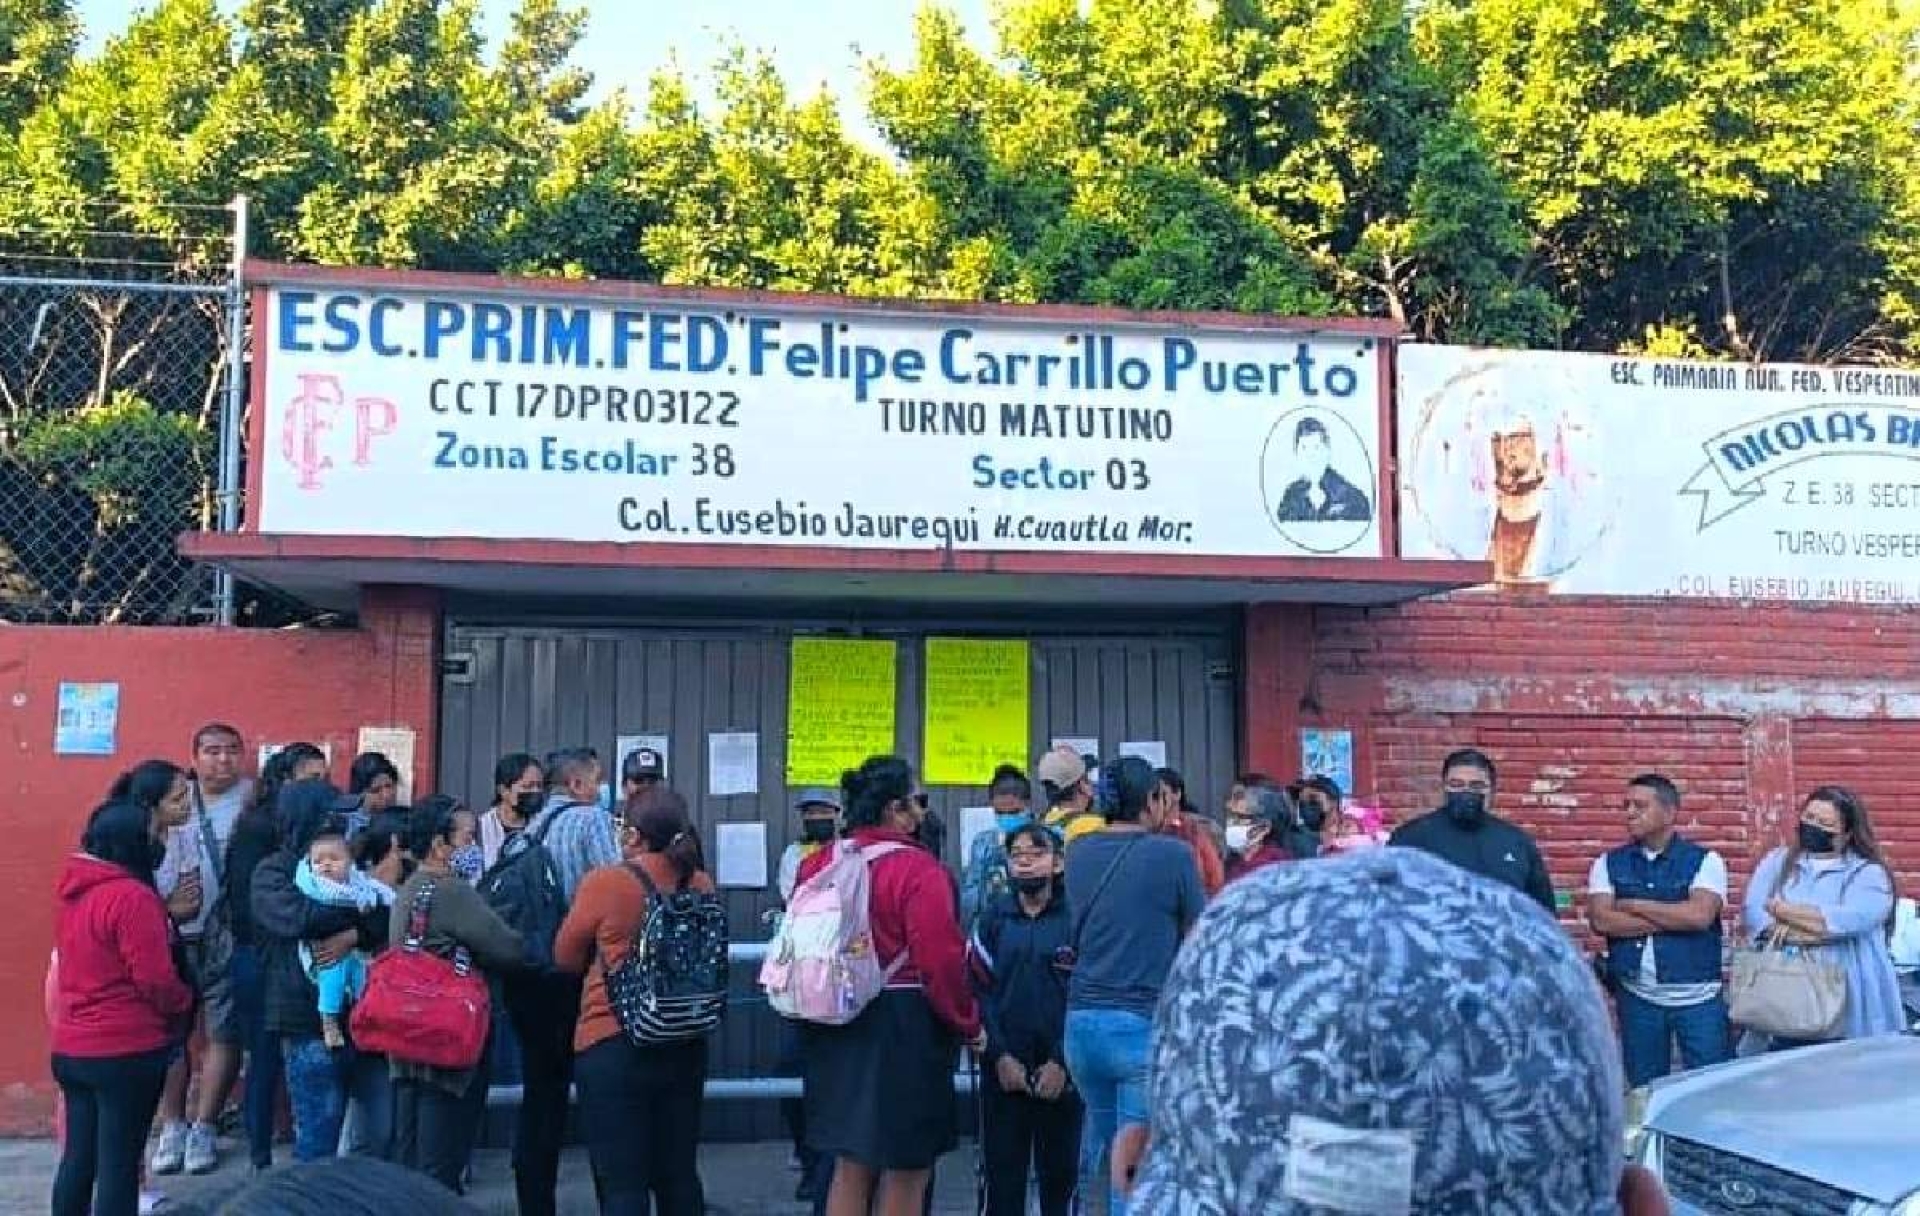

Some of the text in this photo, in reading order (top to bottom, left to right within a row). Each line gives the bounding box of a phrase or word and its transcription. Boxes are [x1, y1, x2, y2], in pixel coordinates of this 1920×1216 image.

[940, 328, 1151, 390] Carrillo
[429, 378, 502, 416] CCT
[1791, 369, 1826, 392] FED.
[878, 398, 1173, 441] TURNO MATUTINO
[434, 431, 736, 478] Zona Escolar 38
[1720, 411, 1876, 471] NICOLAS
[972, 454, 1152, 491] Sector 03
[1833, 482, 1854, 505] 38
[618, 497, 690, 534] Col.
[695, 497, 827, 537] Eusebio
[1774, 530, 1847, 556] TURNO
[1728, 575, 1809, 599] EUSEBIO
